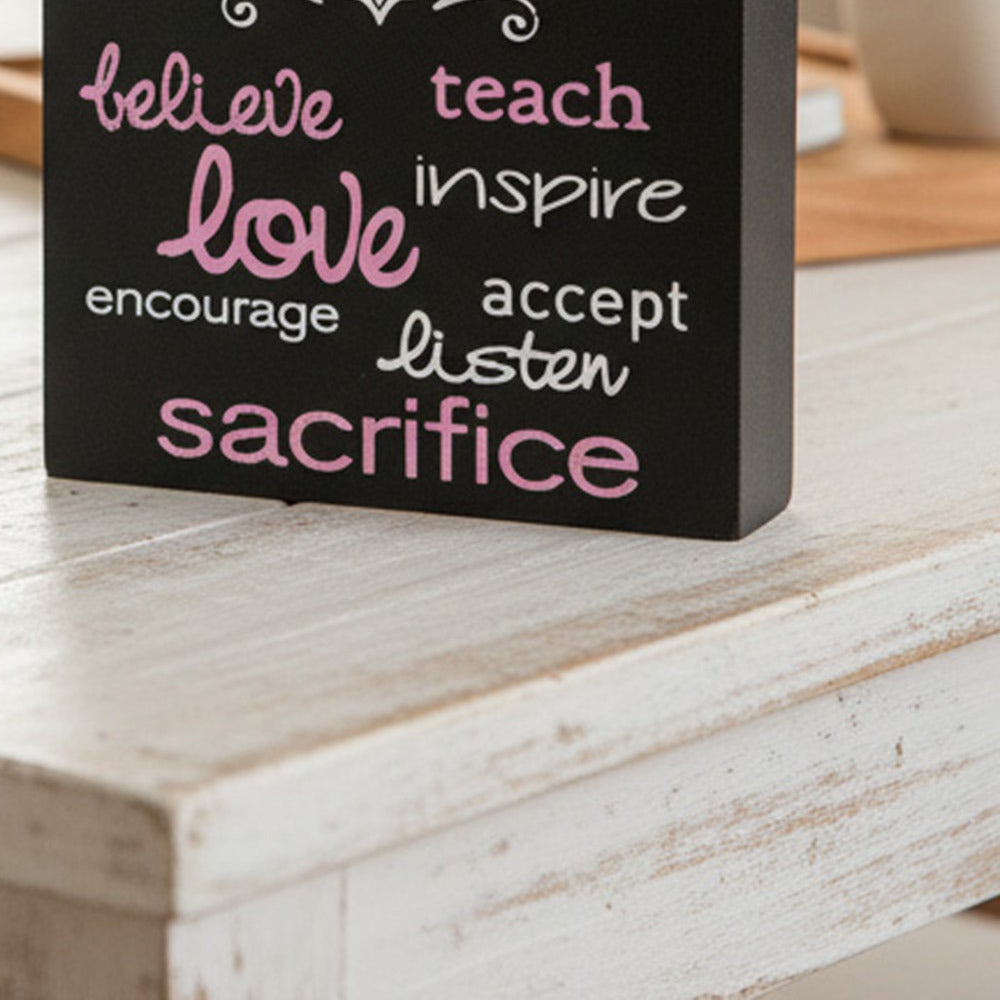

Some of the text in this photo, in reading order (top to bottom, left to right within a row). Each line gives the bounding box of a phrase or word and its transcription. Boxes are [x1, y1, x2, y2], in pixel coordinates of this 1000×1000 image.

[79, 42, 342, 140] believe
[431, 63, 650, 131] teach
[157, 144, 420, 288] love
[415, 155, 687, 228] inspire
[85, 285, 340, 343] encourage
[482, 278, 689, 343] accept
[376, 309, 630, 397] listen
[157, 396, 640, 499] sacrifice
